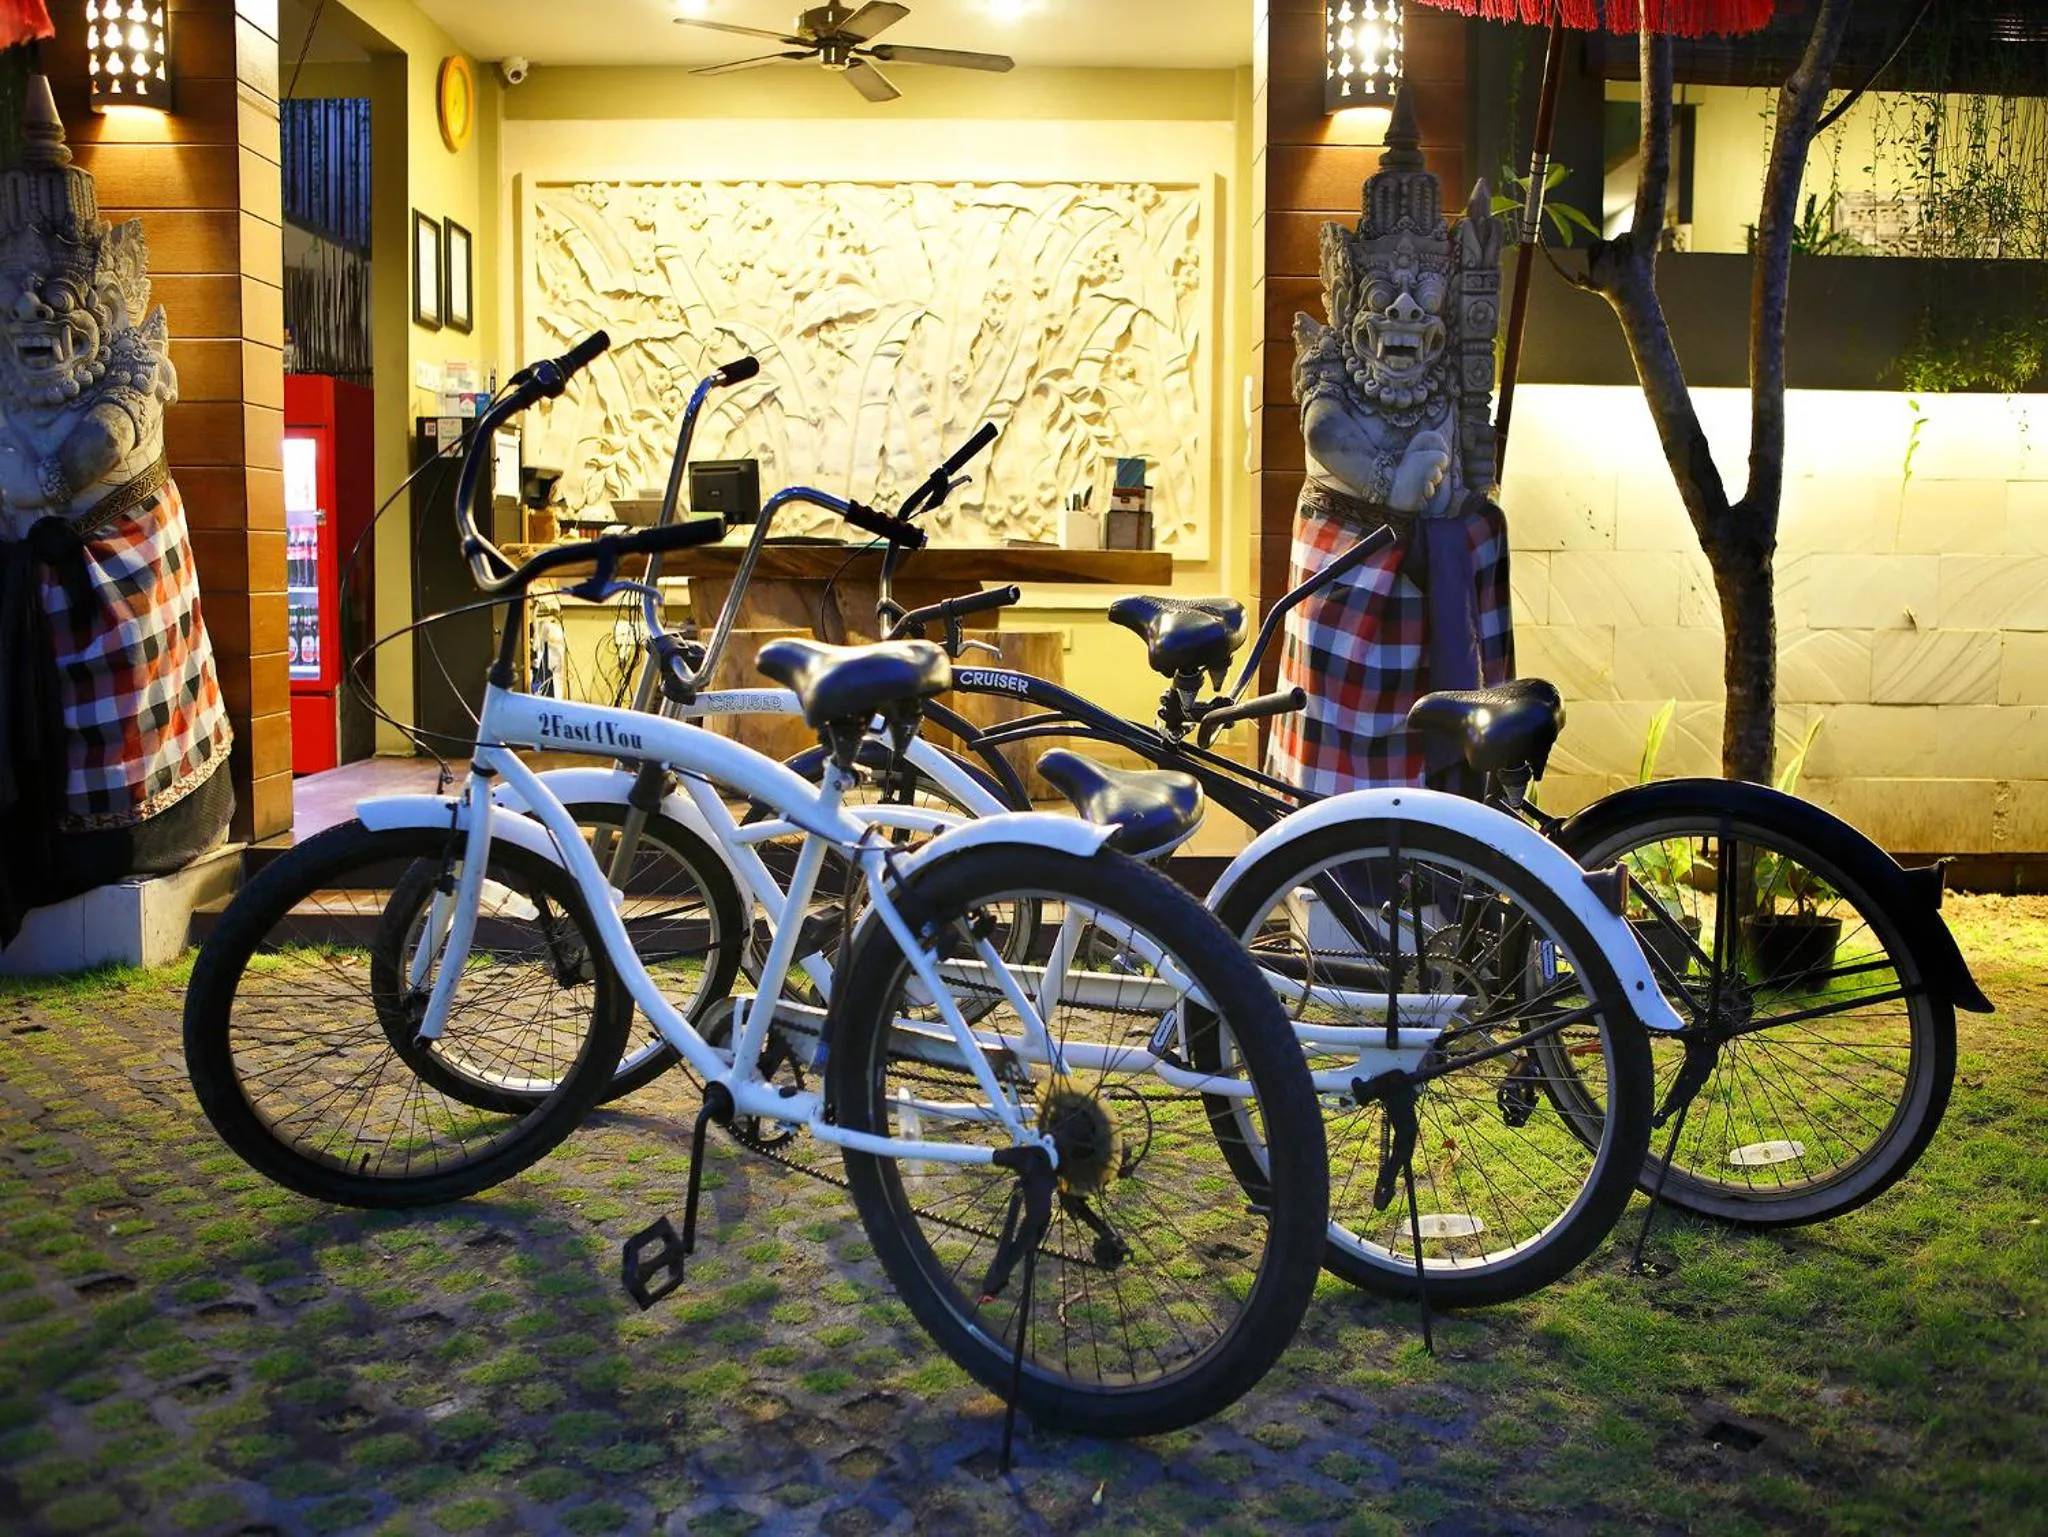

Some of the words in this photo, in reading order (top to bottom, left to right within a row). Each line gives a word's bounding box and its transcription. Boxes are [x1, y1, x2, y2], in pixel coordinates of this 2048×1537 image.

[960, 671, 1029, 694] CRUISER
[708, 694, 784, 712] CRUISER
[538, 712, 643, 750] 2Fast4You
